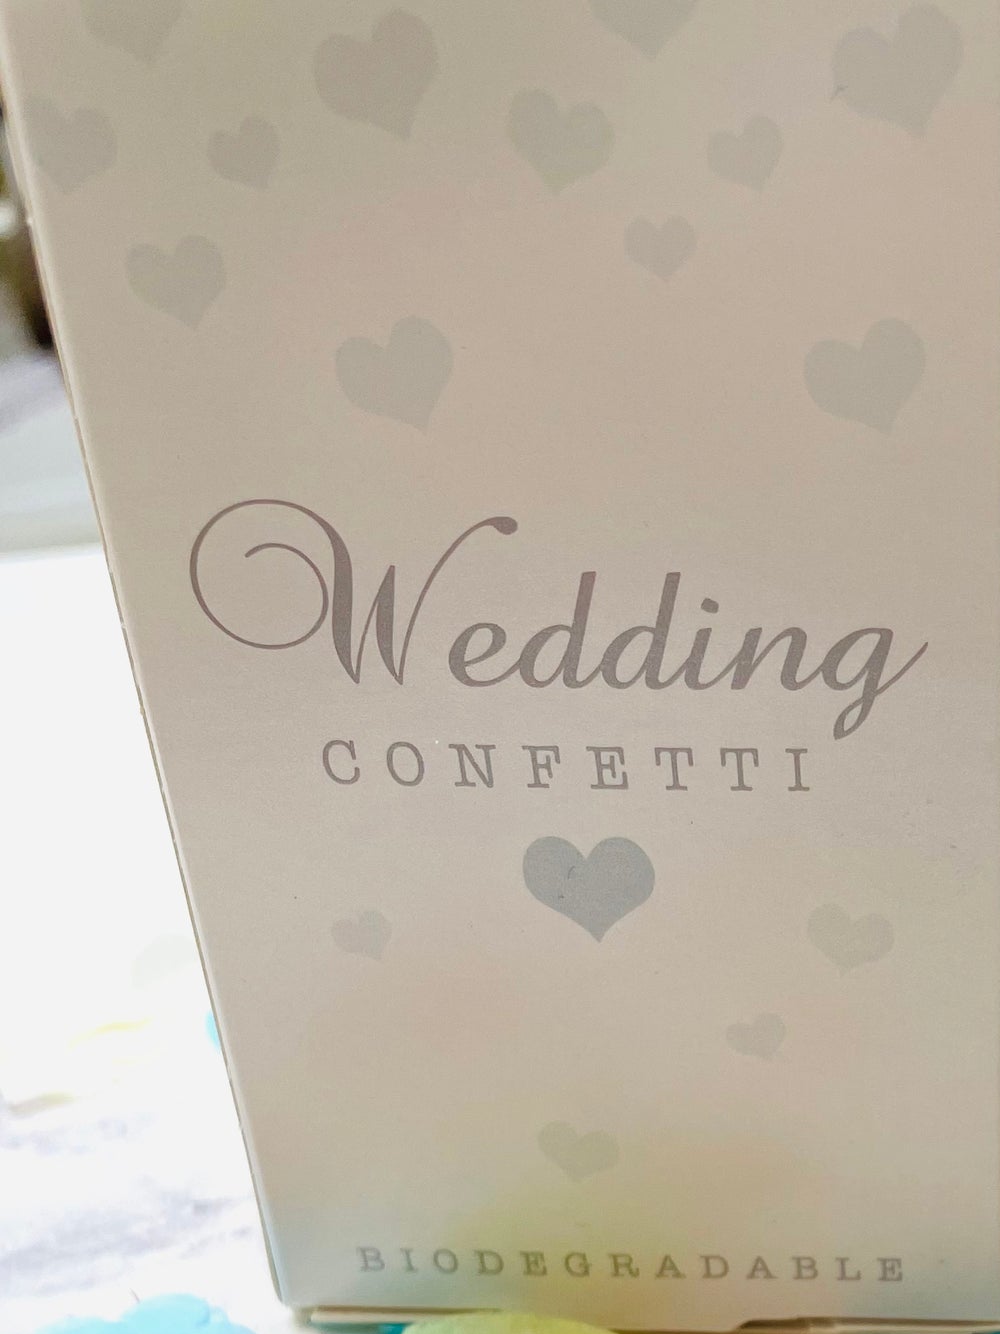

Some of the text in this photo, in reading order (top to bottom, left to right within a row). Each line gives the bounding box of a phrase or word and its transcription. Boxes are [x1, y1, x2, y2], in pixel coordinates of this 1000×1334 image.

[189, 498, 929, 740] Wedding
[321, 739, 812, 793] CONFETTI
[357, 1246, 904, 1283] BIODEGRADABLE
